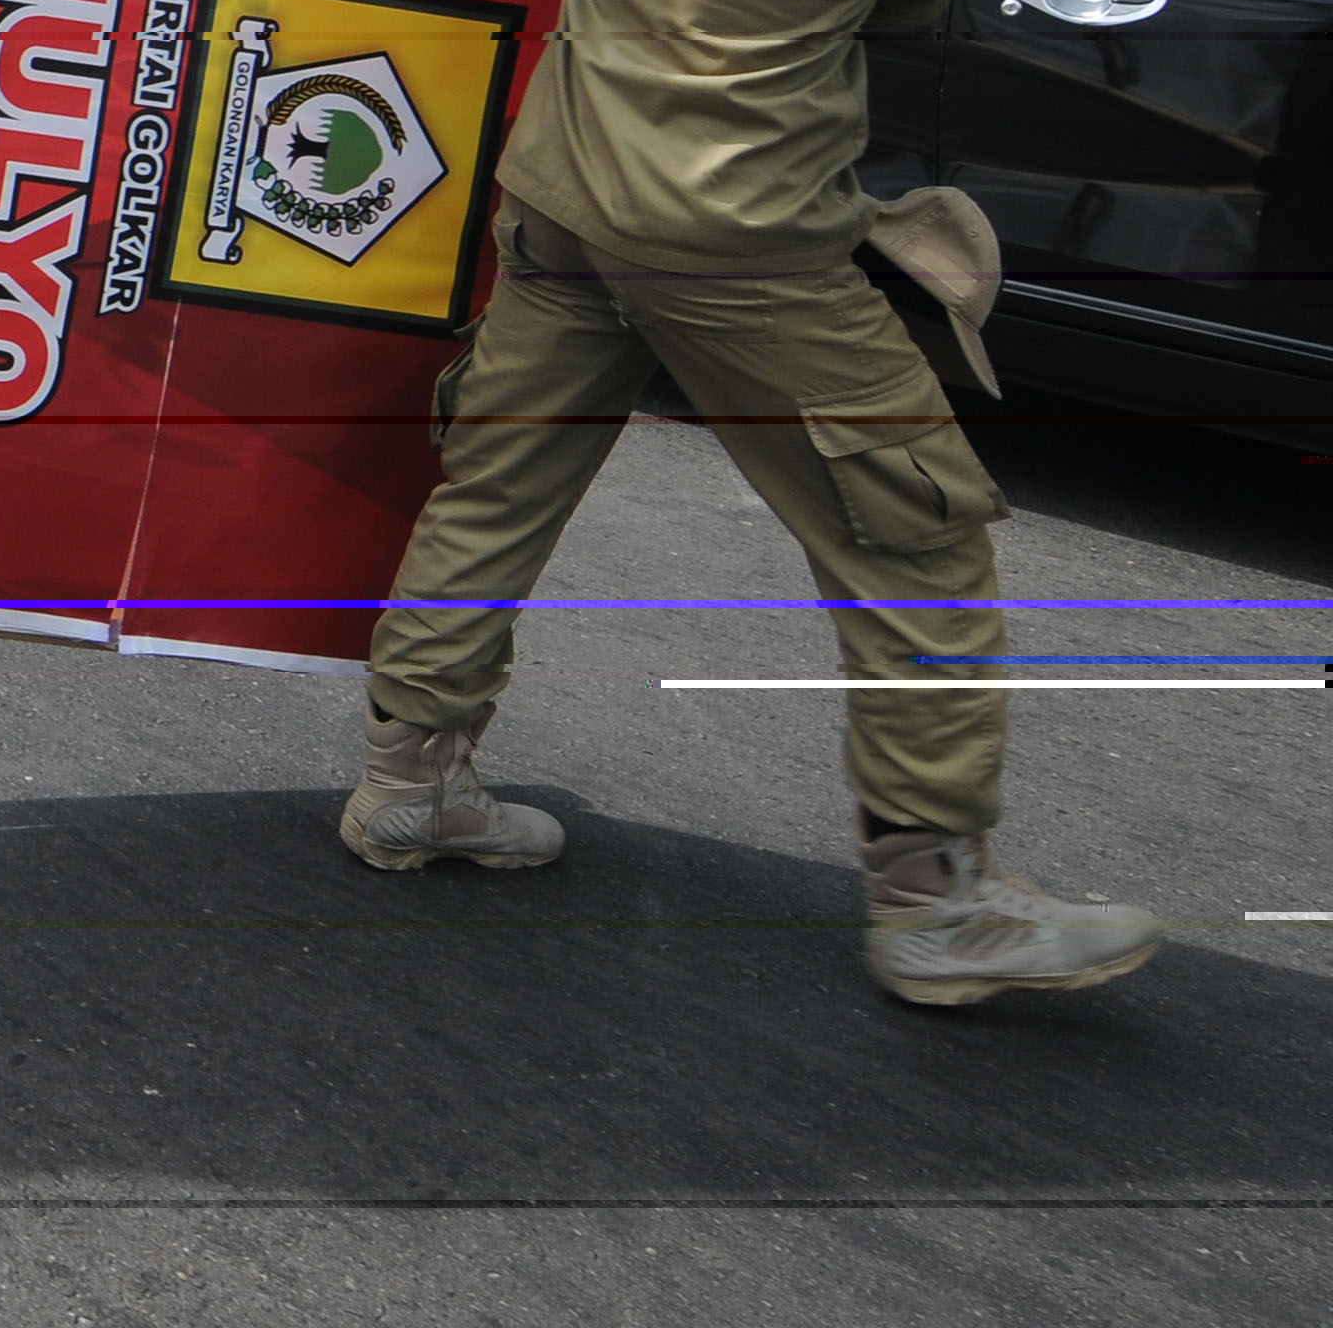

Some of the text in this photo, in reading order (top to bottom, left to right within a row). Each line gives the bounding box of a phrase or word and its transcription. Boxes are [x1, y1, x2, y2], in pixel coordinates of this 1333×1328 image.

[106, 116, 167, 310] GOLKAR
[211, 60, 251, 218] GOLONGAN KARYA
